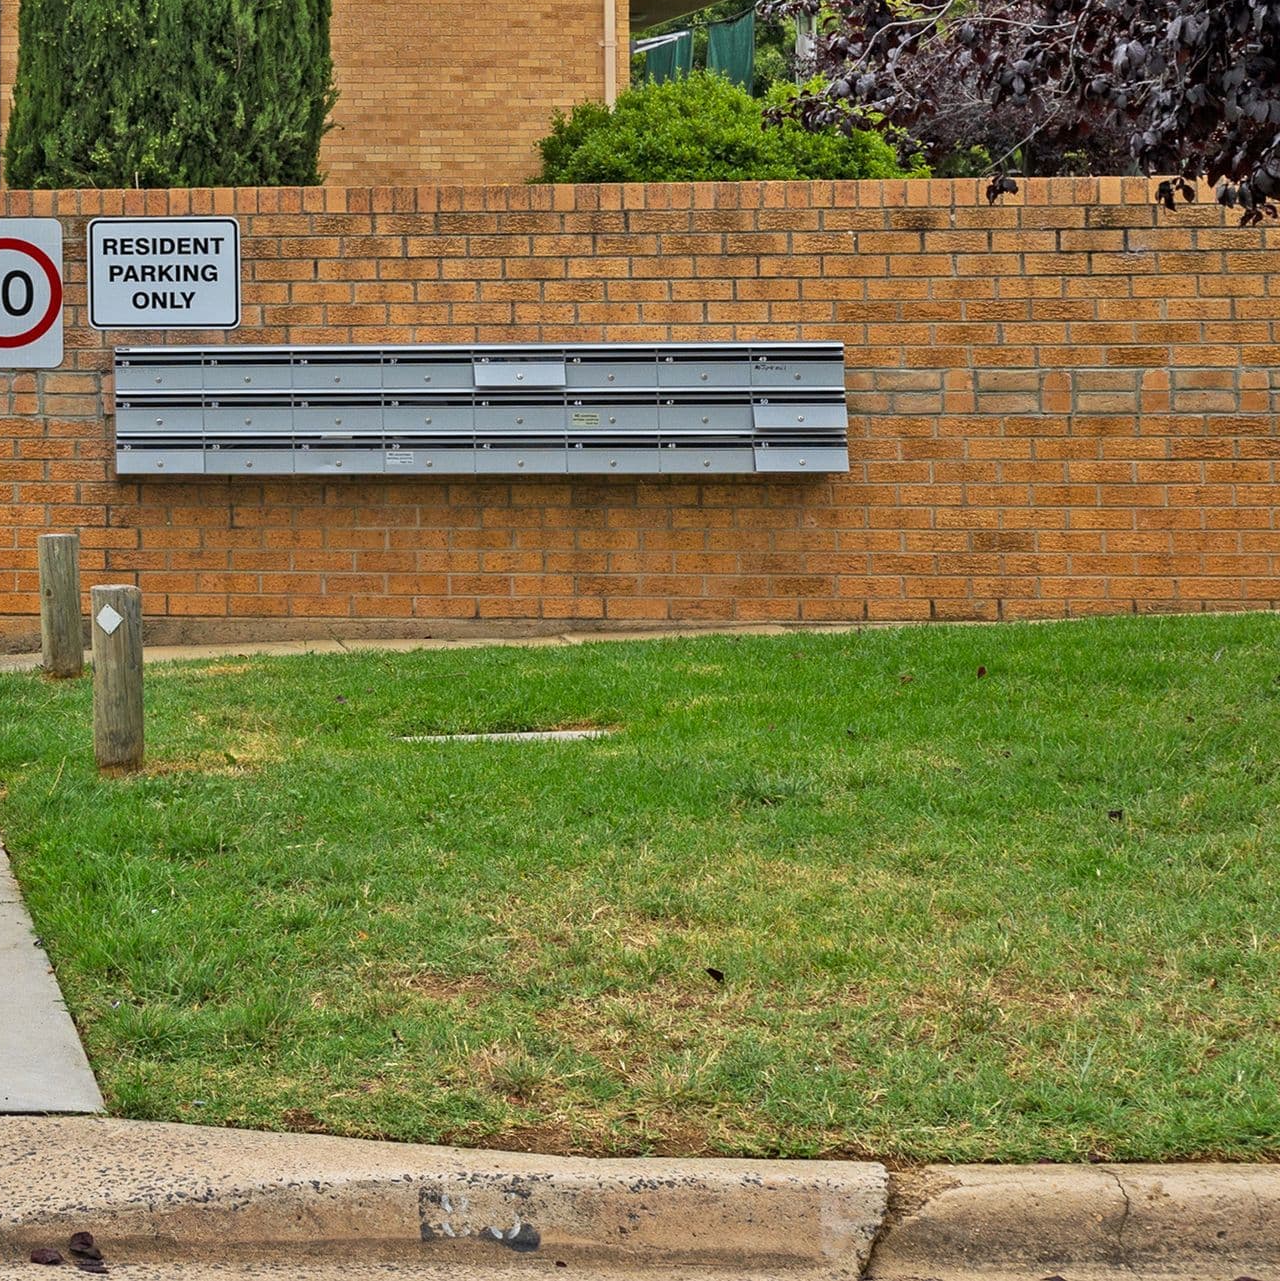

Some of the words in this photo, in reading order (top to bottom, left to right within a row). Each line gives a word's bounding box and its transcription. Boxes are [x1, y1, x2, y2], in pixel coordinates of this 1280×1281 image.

[102, 237, 225, 256] RESIDENT
[109, 264, 218, 283] PARKING
[132, 291, 196, 310] ONLY
